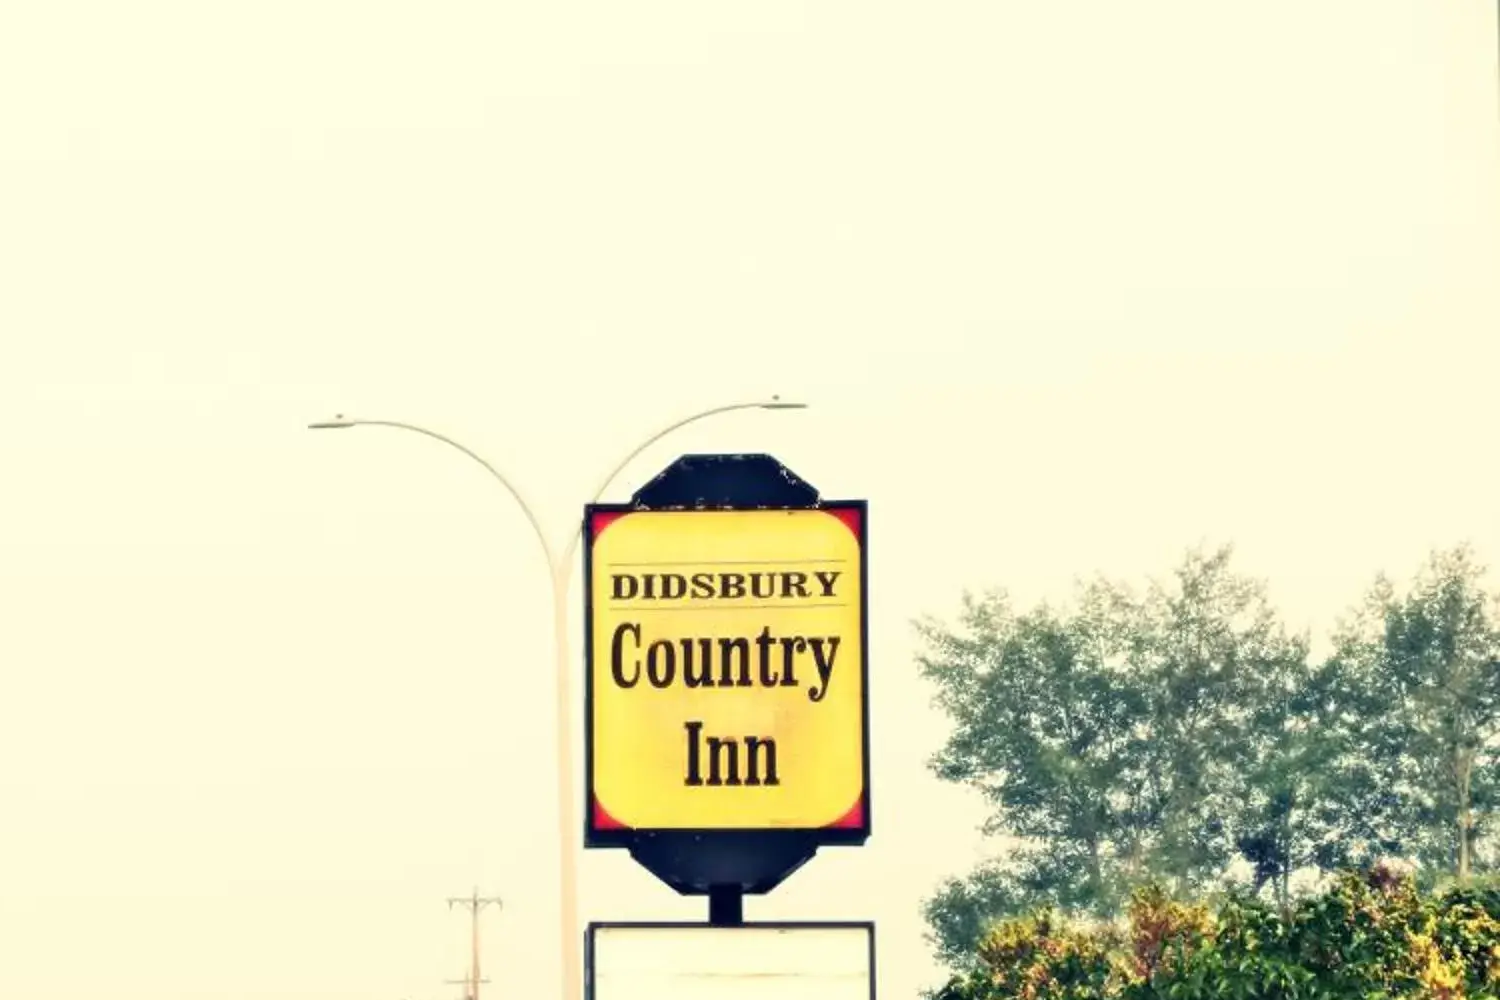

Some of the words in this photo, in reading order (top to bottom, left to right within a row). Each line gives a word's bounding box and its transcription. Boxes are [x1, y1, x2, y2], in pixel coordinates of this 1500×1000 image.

[611, 571, 842, 600] DIDSBURY
[611, 622, 841, 701] Country
[684, 721, 780, 787] Inn
